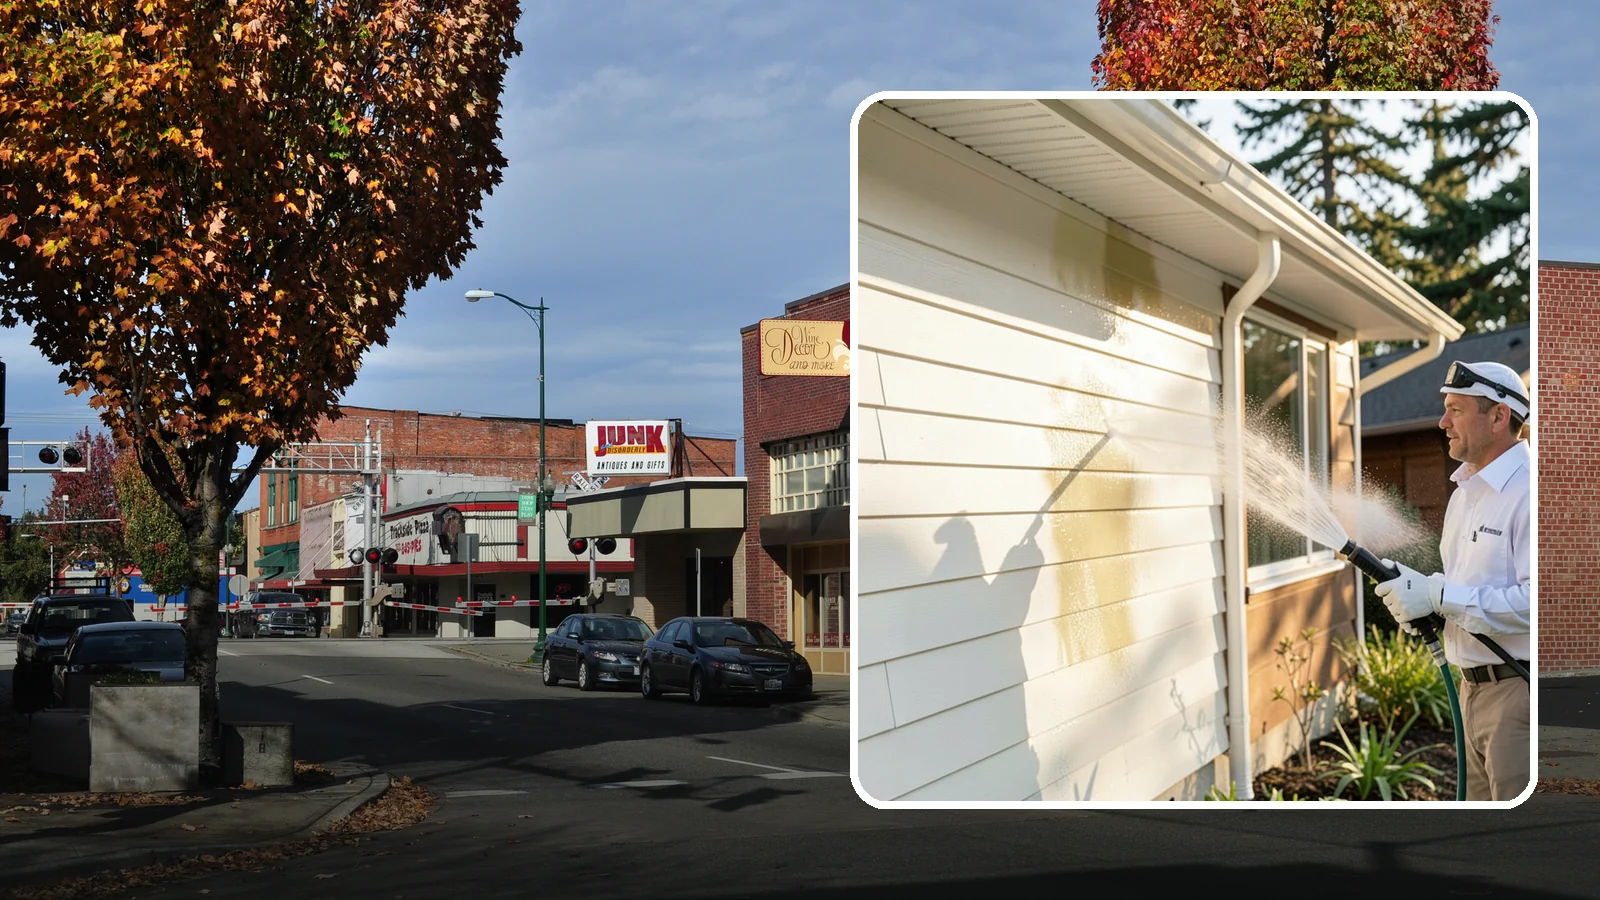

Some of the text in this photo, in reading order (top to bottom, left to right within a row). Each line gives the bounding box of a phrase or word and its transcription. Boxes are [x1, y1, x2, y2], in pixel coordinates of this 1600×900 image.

[595, 425, 666, 457] JUNK
[607, 446, 646, 454] DISORDERLY
[597, 460, 665, 470] ANTIQUES AND GIFTS
[590, 476, 608, 491] SING
